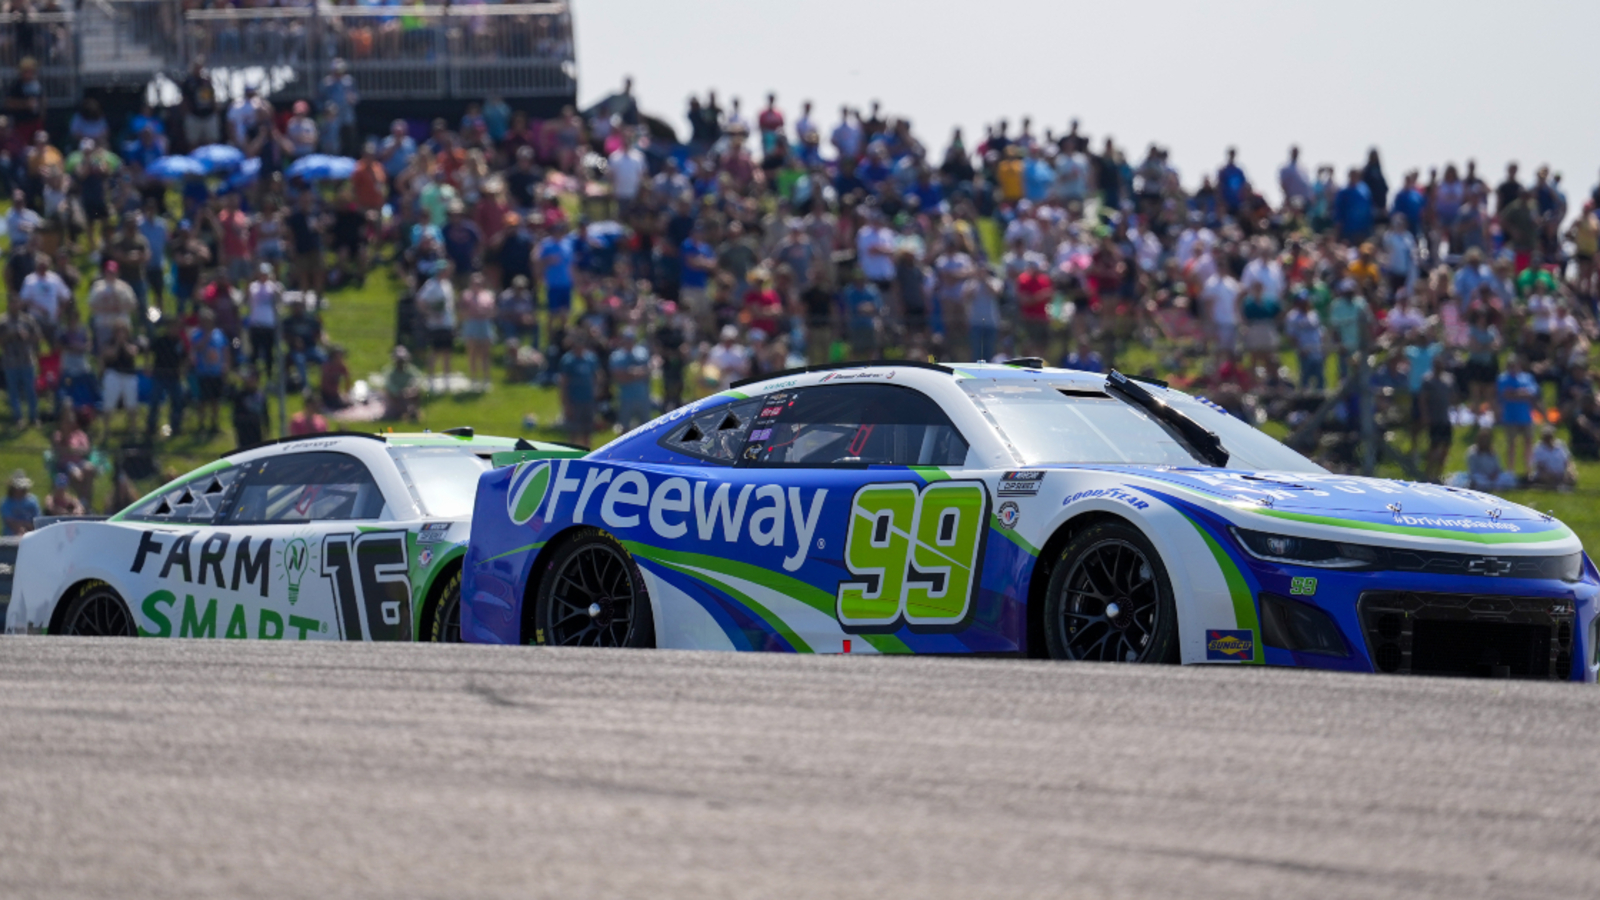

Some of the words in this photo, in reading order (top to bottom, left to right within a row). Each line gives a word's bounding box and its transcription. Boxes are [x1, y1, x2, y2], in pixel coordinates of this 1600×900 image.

[545, 459, 827, 572] Freeway
[1062, 488, 1149, 511] GOODYEAR
[130, 530, 273, 597] FARM
[321, 529, 413, 642] 16
[836, 478, 992, 634] 99
[1290, 576, 1317, 596] 99
[1209, 640, 1252, 651] SUNOCO
